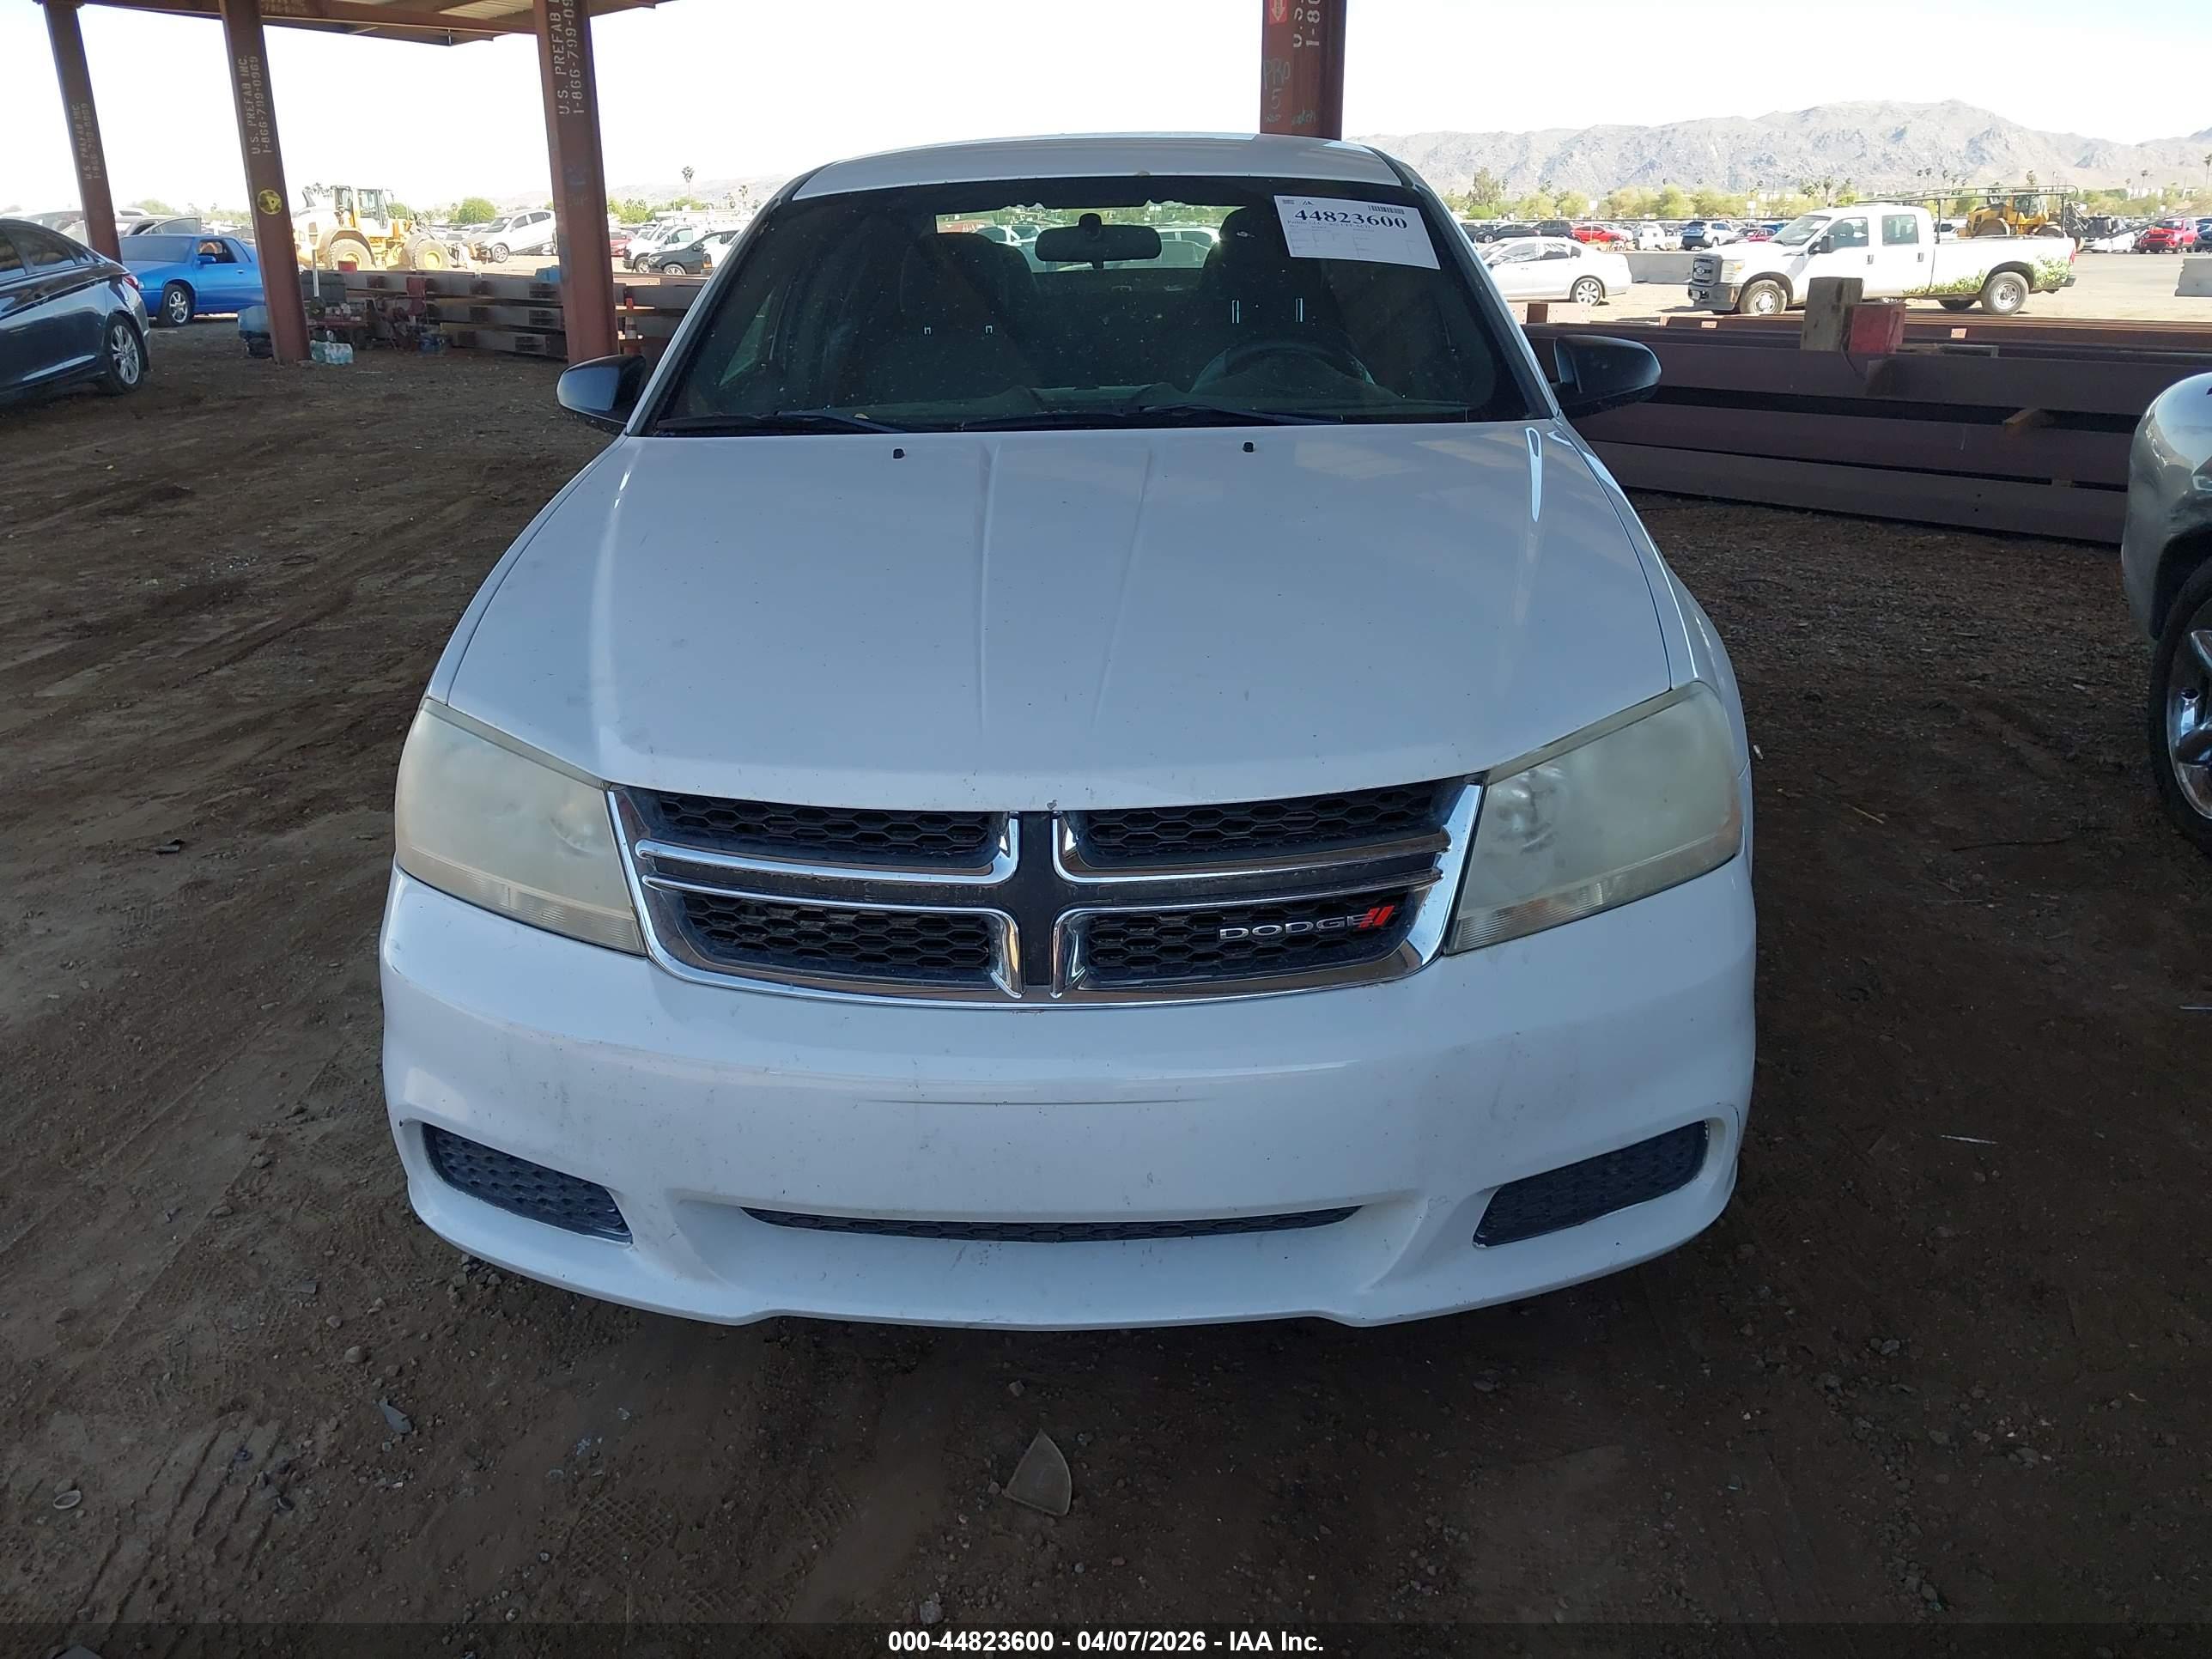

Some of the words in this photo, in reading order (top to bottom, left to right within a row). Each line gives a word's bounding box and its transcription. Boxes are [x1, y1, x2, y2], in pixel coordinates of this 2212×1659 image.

[550, 12, 567, 76] PREFAB
[241, 82, 257, 128] PREFAB
[557, 85, 570, 115] U.S.
[1294, 209, 1408, 230] 44823600
[1219, 915, 1373, 940] DODGE
